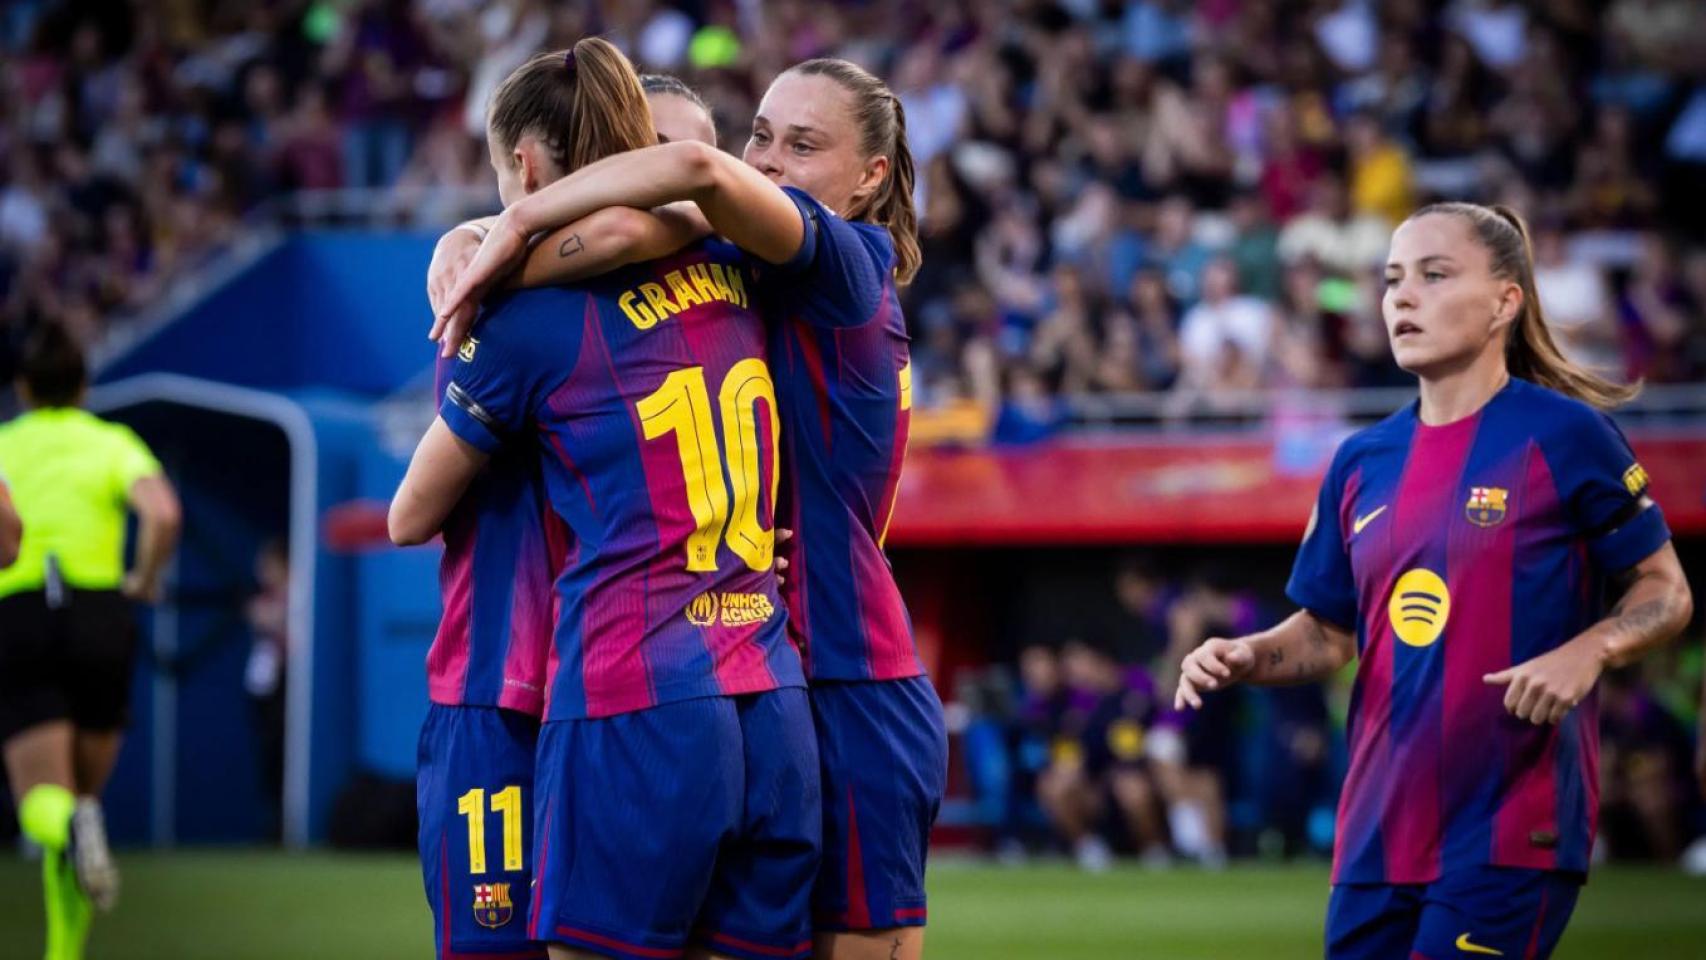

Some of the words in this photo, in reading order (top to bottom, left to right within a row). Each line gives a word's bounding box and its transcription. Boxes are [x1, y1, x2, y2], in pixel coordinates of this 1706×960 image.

[618, 262, 748, 331] GRAHAM
[635, 357, 781, 573] 10
[720, 592, 772, 609] UNHCR
[721, 606, 775, 622] ACNUR
[458, 785, 523, 874] 11
